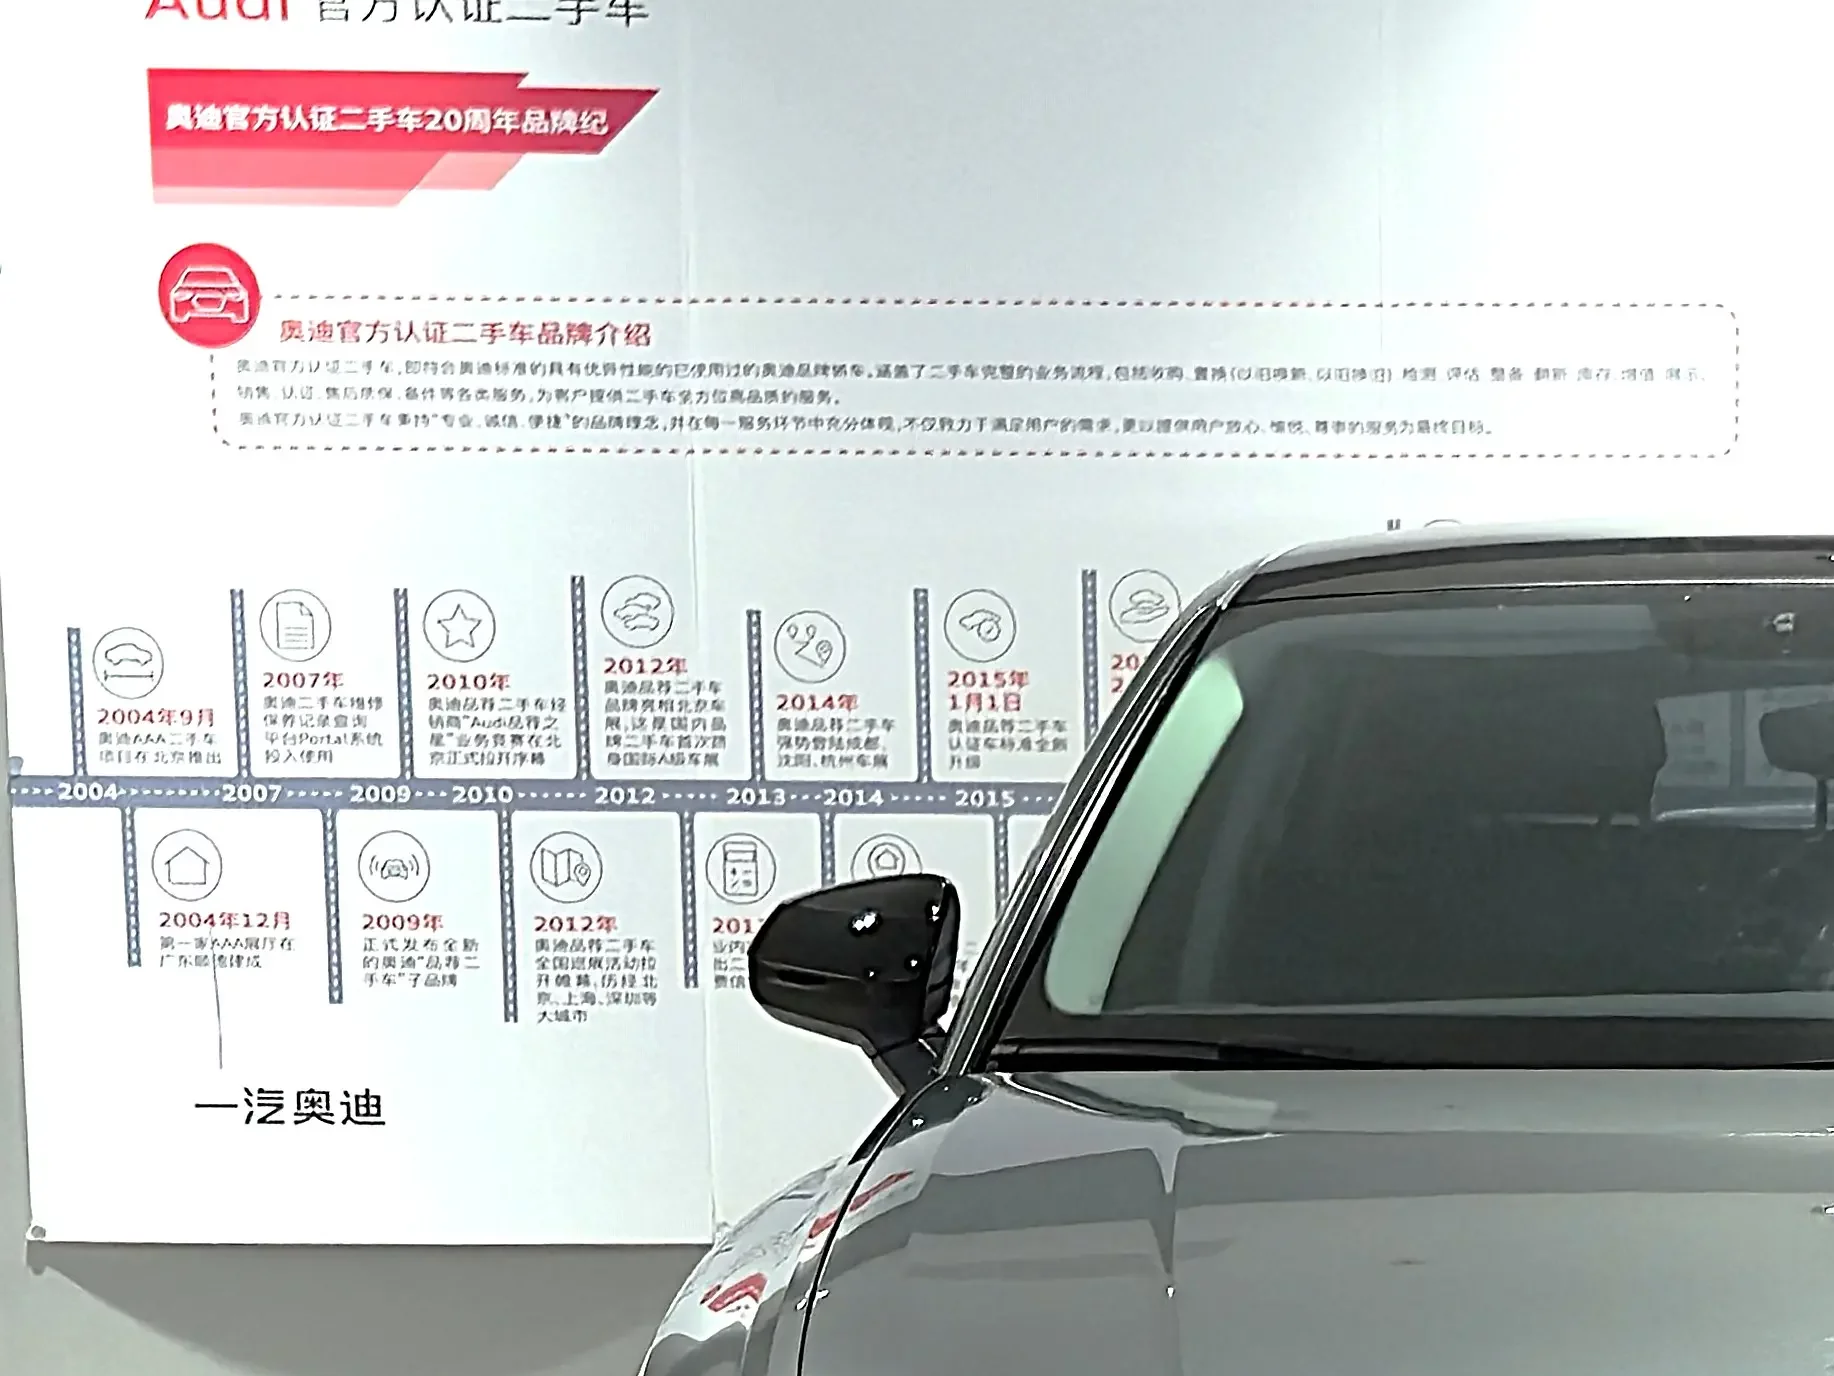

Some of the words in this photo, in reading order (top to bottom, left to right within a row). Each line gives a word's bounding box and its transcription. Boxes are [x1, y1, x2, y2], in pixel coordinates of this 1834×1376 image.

[319, 0, 650, 26] 官方认证二手车
[165, 103, 610, 136] 奥迪官方认证二手车20周年品牌纪
[279, 319, 652, 347] 奥迪官方认证二手车品牌介绍
[603, 657, 688, 675] 2012年
[263, 671, 344, 689] 2007年
[427, 672, 510, 691] 2010年
[947, 670, 1029, 689] 2015年
[776, 693, 858, 712] 2014年
[949, 692, 1022, 714] 1月1日
[97, 707, 214, 727] 2004年9月
[264, 748, 333, 764] 投入使用
[948, 754, 981, 771] 升级
[58, 782, 121, 800] 2004
[222, 784, 281, 802] 2007
[350, 784, 411, 802] 2009
[452, 786, 513, 804] 2010
[595, 787, 655, 804] 2012
[727, 788, 785, 805] 2013
[824, 789, 884, 806] 2014
[956, 790, 1014, 807] 2015
[159, 911, 290, 930] 2004年12月
[362, 913, 444, 932] 2009年
[534, 915, 618, 933] 2012年
[537, 1008, 588, 1024] 大城市
[194, 1087, 386, 1126] 一汽奥迪
